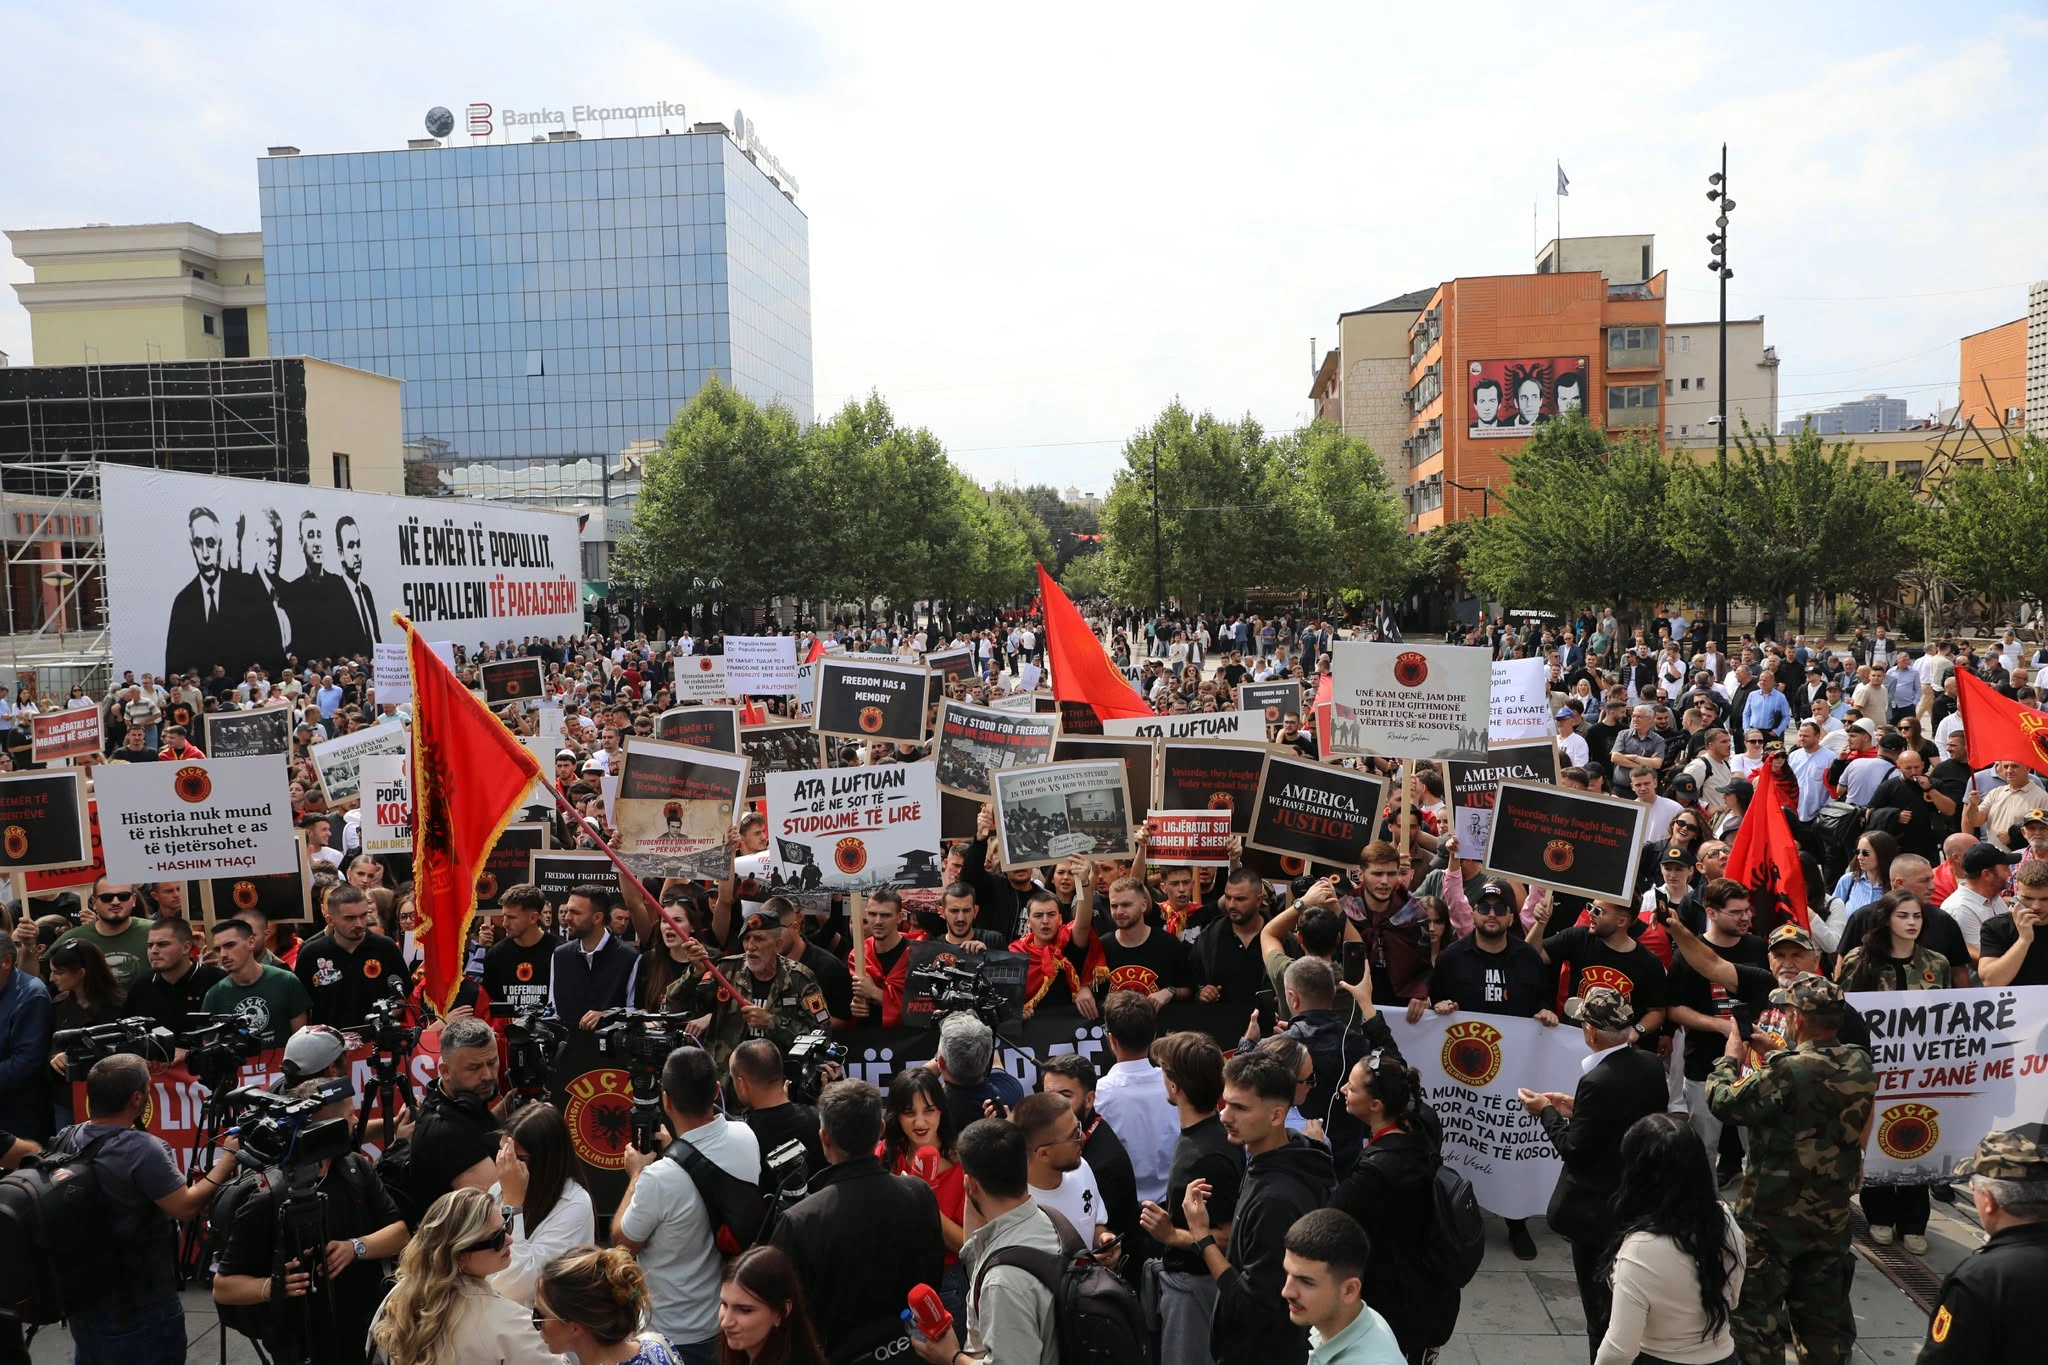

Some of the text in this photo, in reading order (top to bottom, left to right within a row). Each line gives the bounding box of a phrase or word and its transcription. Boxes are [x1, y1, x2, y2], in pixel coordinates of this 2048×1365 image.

[503, 101, 686, 126] Banka Ekonomike
[399, 516, 554, 571] NË EMËR TË POPULLIT,
[403, 574, 578, 622] SHPALLENI TË PAFAJSHËM!
[1401, 653, 1422, 661] UÇK
[842, 676, 906, 691] FREEDOM HAS A
[855, 692, 892, 704] MEMORY
[1399, 691, 1425, 701] QENË,
[1427, 694, 1444, 702] JAM
[1353, 708, 1388, 717] USHTAR
[1396, 711, 1427, 720] UÇK-së
[1429, 713, 1448, 721] DHE
[1456, 713, 1467, 721] TË
[1388, 701, 1405, 709] JEM
[1407, 702, 1460, 712] GJITHMONË
[1506, 705, 1545, 714] GJYKATË
[49, 717, 97, 735] LIGJËRATAT SOT
[949, 712, 1050, 736] THEY STOOD FOR FREEDOM.
[1170, 716, 1239, 737] LUFTUAN
[1360, 718, 1462, 731] VËRTETËS SË KOSOVËS.
[1506, 718, 1545, 726] RACISTE.
[78, 728, 99, 740] SHESH
[965, 727, 978, 739] WE
[178, 767, 203, 777] UÇK
[1020, 770, 1109, 788] HOW OUR PARENTS STUDIED
[1211, 768, 1227, 779] they
[1464, 764, 1539, 783] AMERICA,
[393, 780, 403, 788] NË
[635, 782, 658, 794] Today
[692, 790, 703, 799] for
[669, 776, 721, 792] they for
[794, 768, 906, 802] ATA LUFTUAN
[1011, 790, 1020, 798] IN
[1020, 788, 1035, 797] THE
[1049, 784, 1061, 793] VS
[1468, 784, 1487, 792] HAVE
[811, 791, 885, 813] QË NE SOT TË
[1281, 784, 1360, 815] AMERICA,
[121, 803, 272, 825] Historia nuk mund
[783, 801, 922, 836] STUDIOJMË TË LIRË
[1268, 796, 1368, 826] WE HAVE FAITH IN YOUR
[1163, 820, 1229, 833] LIGJËRATAT SOT
[1272, 809, 1355, 840] JUSTICE
[1507, 805, 1628, 837] Yesterday, they fought for us.
[129, 823, 268, 841] të rishkruhet e as
[1149, 834, 1199, 847] MBAHEN NË
[1512, 818, 1619, 847] Today we stand for them.
[144, 838, 258, 857] të tjetërsohet.
[390, 839, 405, 849] DHE
[840, 838, 860, 848] UÇK
[1550, 840, 1571, 851] UÇK
[157, 856, 256, 872] HASHIM THAÇI
[544, 872, 617, 881] FREEDOM FIGHTERS
[1112, 967, 1153, 984] UÇK
[1584, 969, 1630, 994] UÇK
[509, 985, 547, 994] DEFENDING
[236, 998, 264, 1011] UÇK
[507, 996, 519, 1005] MY
[1863, 991, 2017, 1040] RIMTARË
[1451, 1023, 1497, 1042] UÇK
[1913, 1035, 1987, 1062] VETËM
[1918, 1058, 2014, 1089] JANË ME
[1432, 1086, 1501, 1111] MUND TË
[1433, 1102, 1515, 1129] POR ASNJË
[1888, 1105, 1933, 1120] UÇK
[567, 1102, 581, 1144] USHTRIA
[1476, 1125, 1496, 1142] TA
[1492, 1146, 1512, 1161] TË
[875, 1336, 910, 1361] ace
